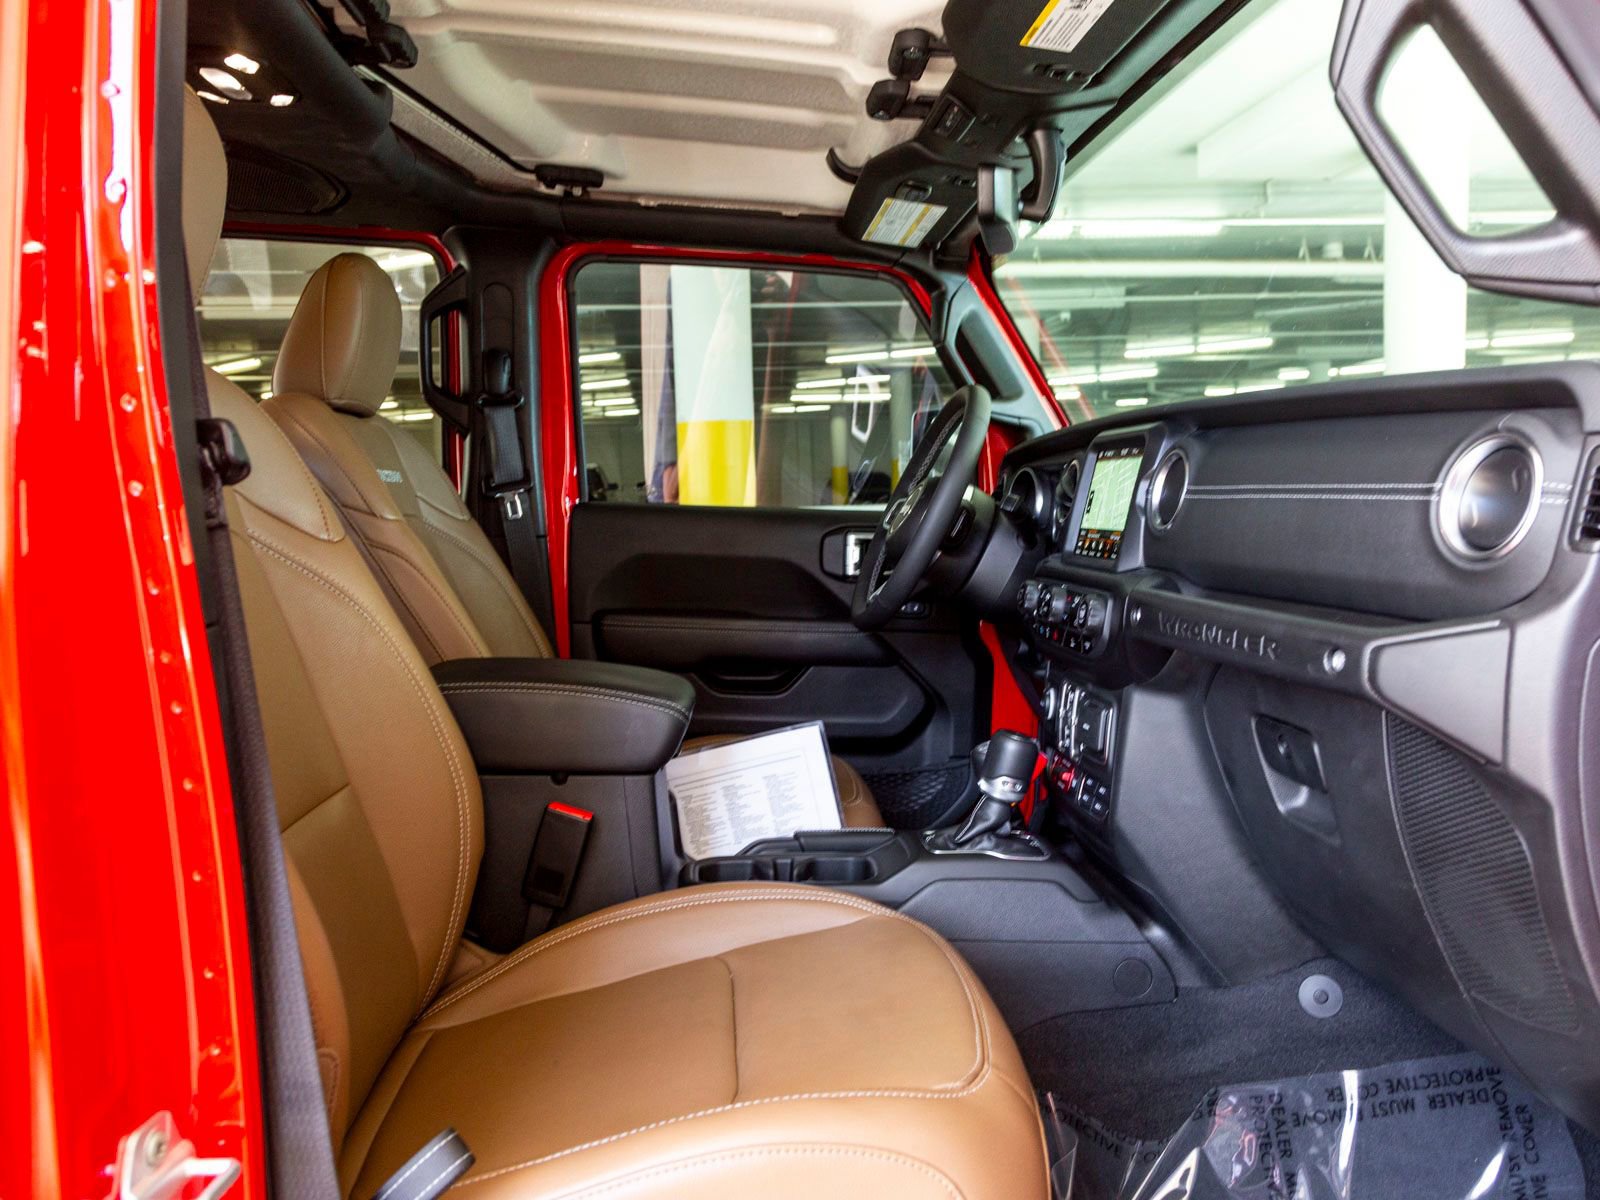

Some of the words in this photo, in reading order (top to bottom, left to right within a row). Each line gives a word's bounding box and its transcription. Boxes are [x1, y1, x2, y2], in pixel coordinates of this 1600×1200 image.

[1385, 1067, 1486, 1094] PROTECTIVE
[1327, 1083, 1380, 1104] COER
[1428, 1086, 1489, 1110] DEALER
[1486, 1066, 1518, 1143] REMOVE
[1292, 1106, 1364, 1128] MOVE
[1371, 1098, 1416, 1119] MUST
[1268, 1092, 1293, 1159] DEALER
[1514, 1103, 1540, 1165] COVER
